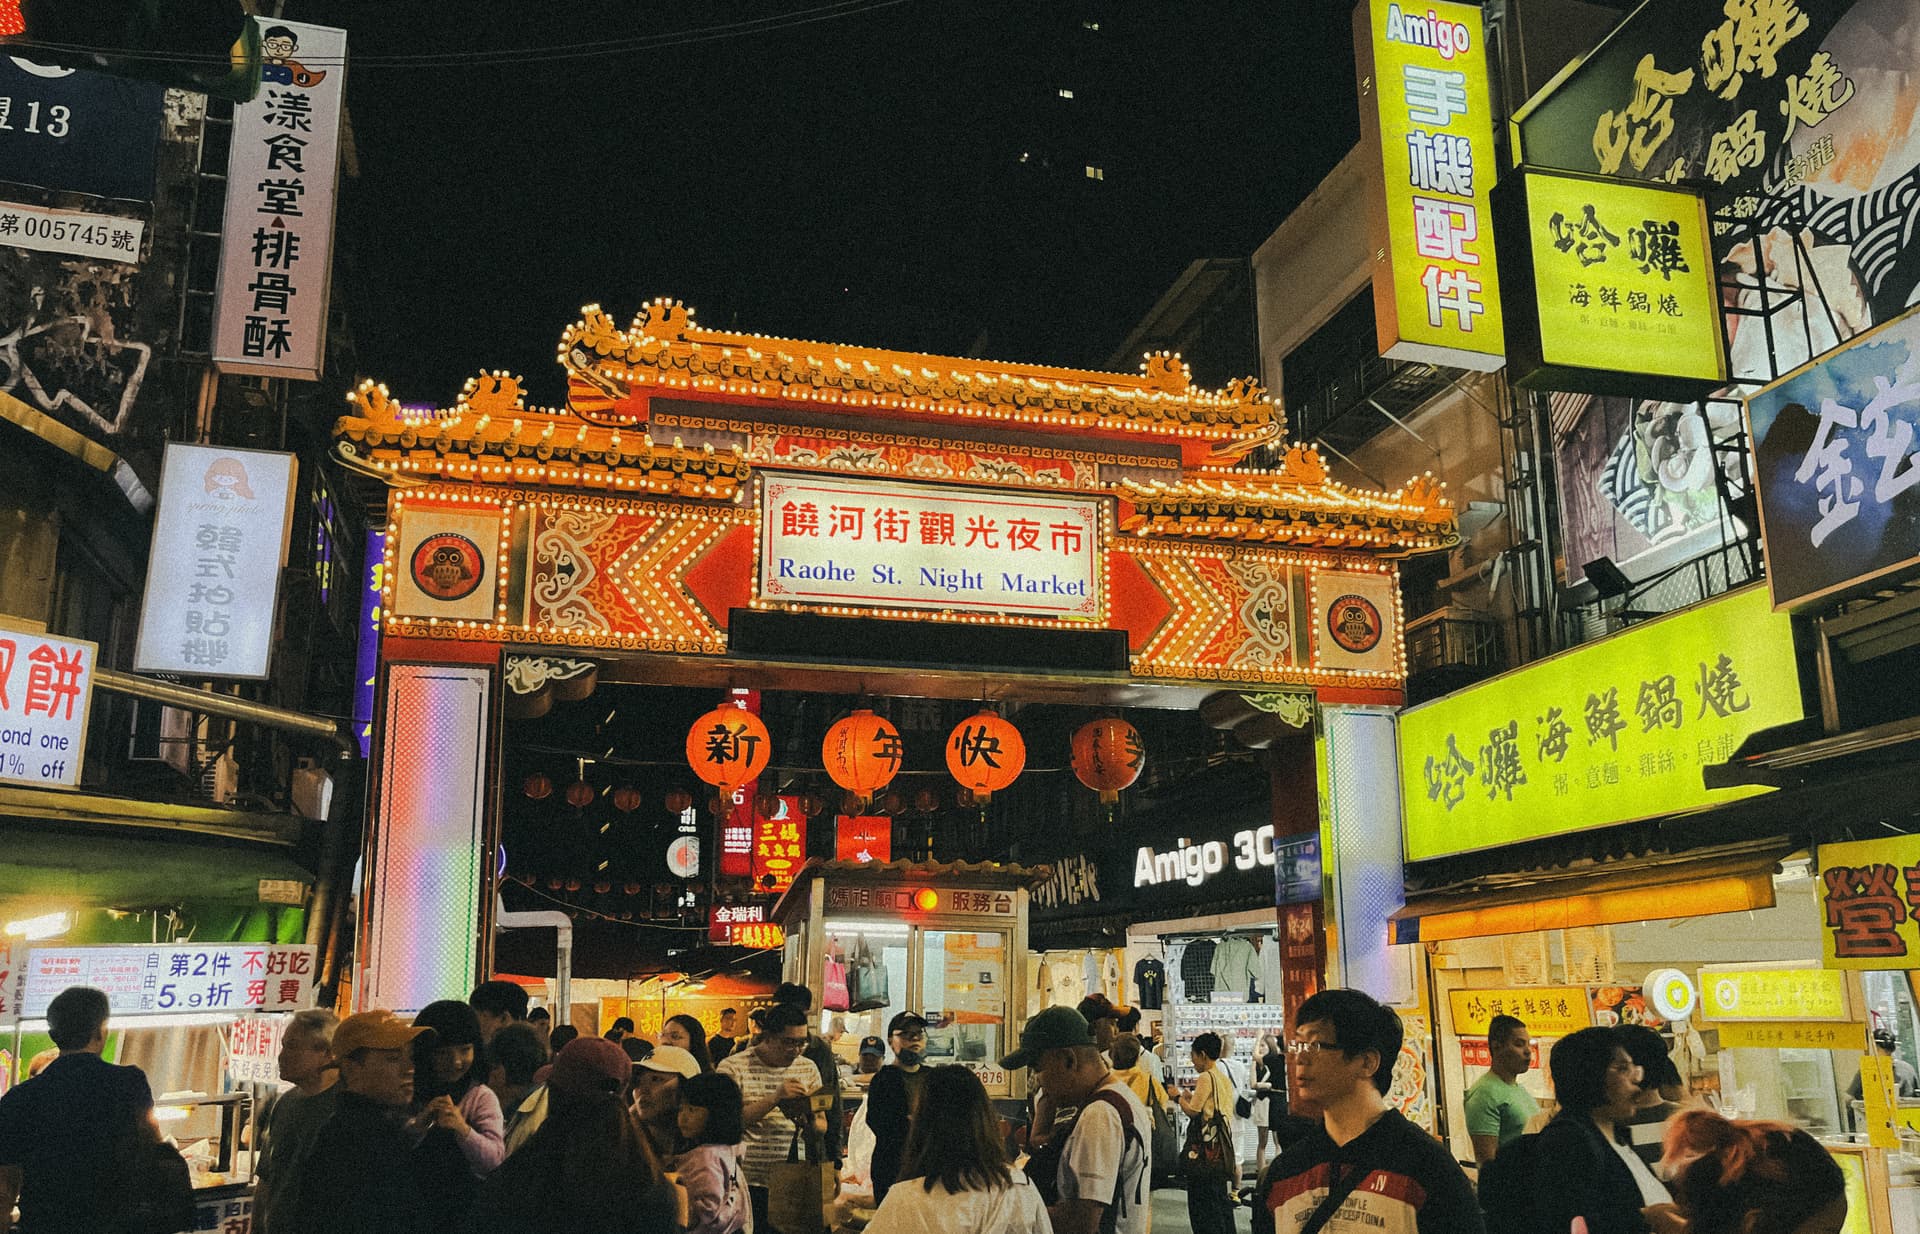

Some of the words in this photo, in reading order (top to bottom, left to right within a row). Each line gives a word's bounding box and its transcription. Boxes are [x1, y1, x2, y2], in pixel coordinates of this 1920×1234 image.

[1386, 3, 1469, 60] Amigo
[1665, 50, 1856, 184] 鍋燒
[257, 90, 312, 217] 漾食堂
[1403, 64, 1484, 332] 手機配件
[0, 213, 135, 251] 第005745號
[1549, 204, 1690, 281] 哈囉
[243, 227, 301, 358] 排骨酥
[1568, 283, 1683, 317] 海鮮鍋燒
[781, 500, 1084, 556] 饒河街觀光夜市
[180, 523, 243, 667] 韓式拍貼機
[778, 557, 856, 582] Raohe
[872, 564, 902, 586] St.
[919, 567, 984, 594] Night
[1001, 572, 1086, 597] Market
[0, 728, 32, 746] ond
[41, 734, 69, 751] one
[706, 723, 762, 769] 新
[872, 726, 903, 773] 年
[955, 724, 1004, 770] 快
[1424, 654, 1751, 812] 哈囉海鮮鍋燒
[41, 760, 66, 779] off
[1134, 838, 1223, 888] Amigo
[716, 906, 763, 923] 金瑞利
[831, 886, 912, 911] 媽祖廟口
[952, 891, 1013, 914] 服務台
[1824, 861, 1920, 959] 營
[141, 952, 160, 1010] 自由配
[169, 952, 231, 977] 第2件
[242, 951, 311, 976] 不好吃
[158, 982, 233, 1009] 5.9折
[244, 980, 300, 1006] 免費
